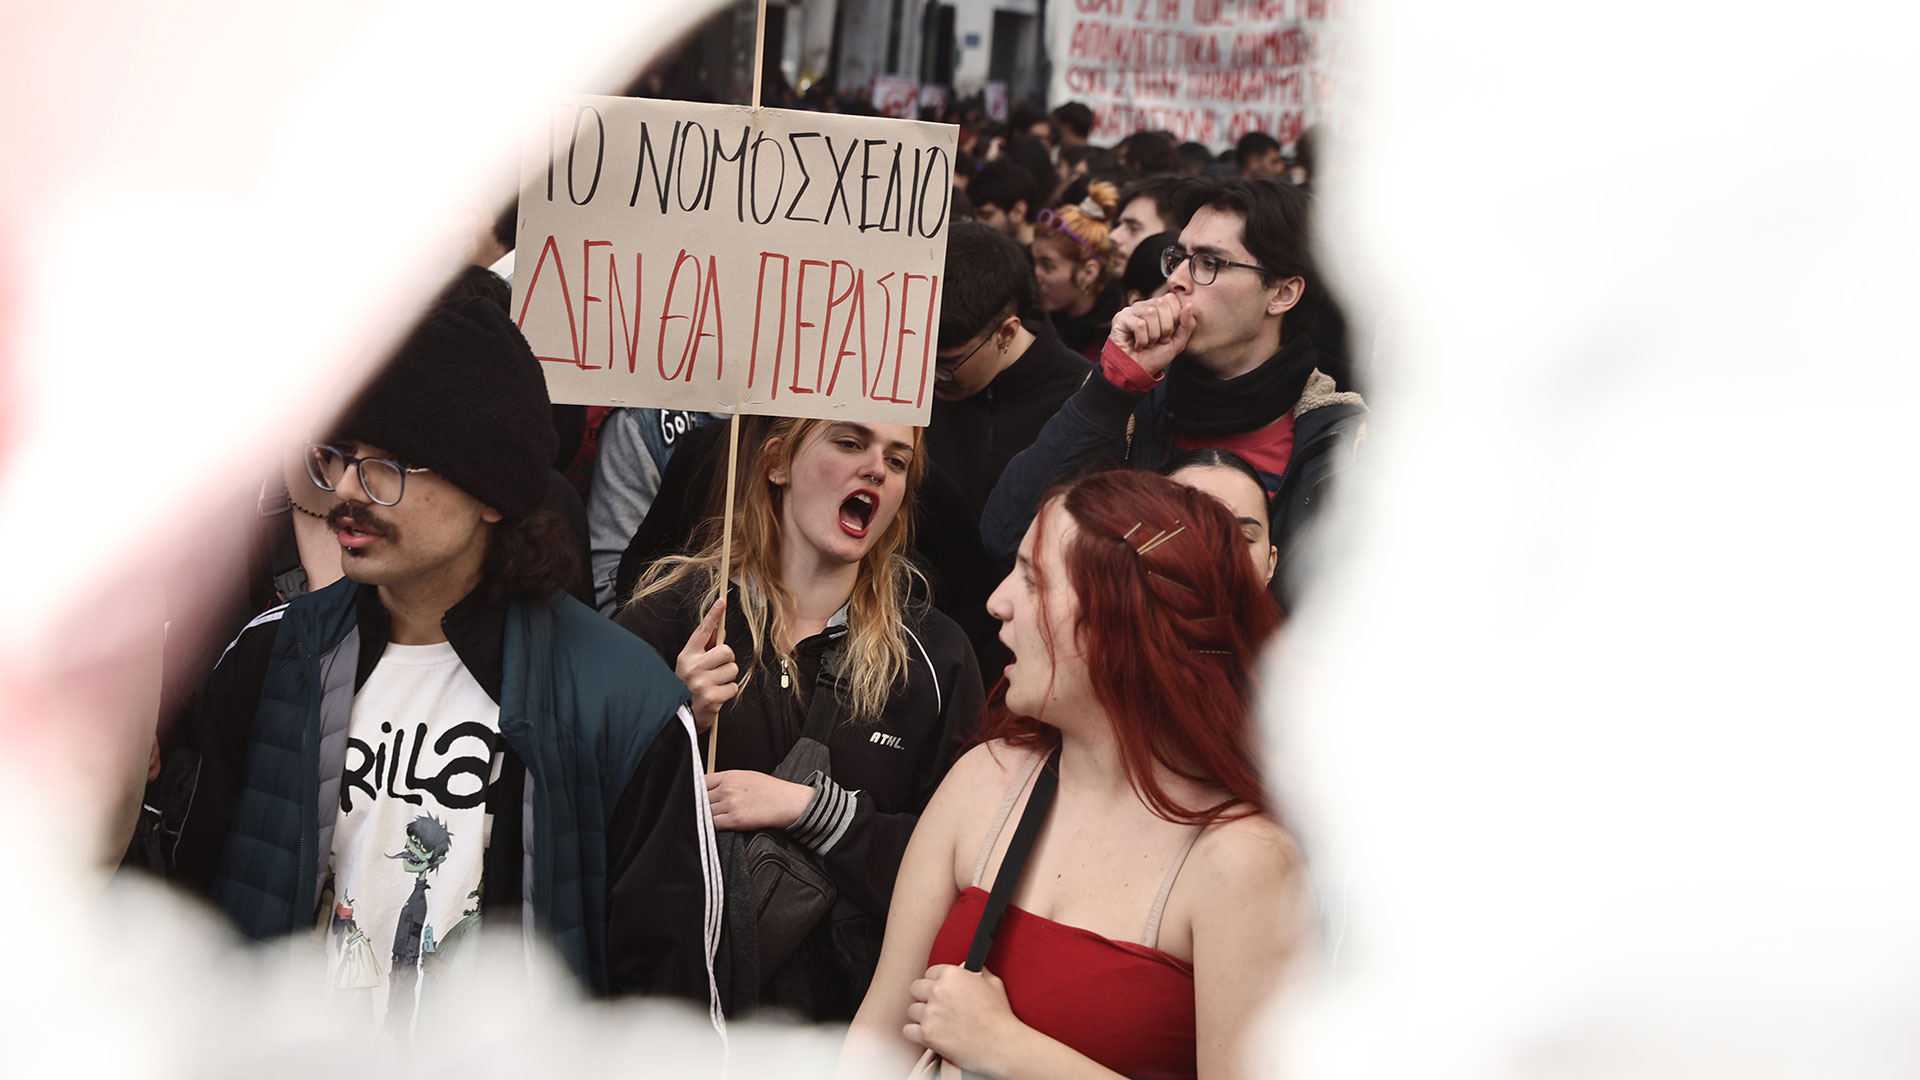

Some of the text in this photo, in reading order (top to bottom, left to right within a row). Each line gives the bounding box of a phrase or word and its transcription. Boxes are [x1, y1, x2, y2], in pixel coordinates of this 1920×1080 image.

[629, 119, 950, 239] ΝΟΜΟΣΧΕΔΙΟ
[516, 235, 939, 409] ΔΕΝ ΘΑ ΠΕΡΑΣΕΙ
[869, 731, 905, 750] ATHL.
